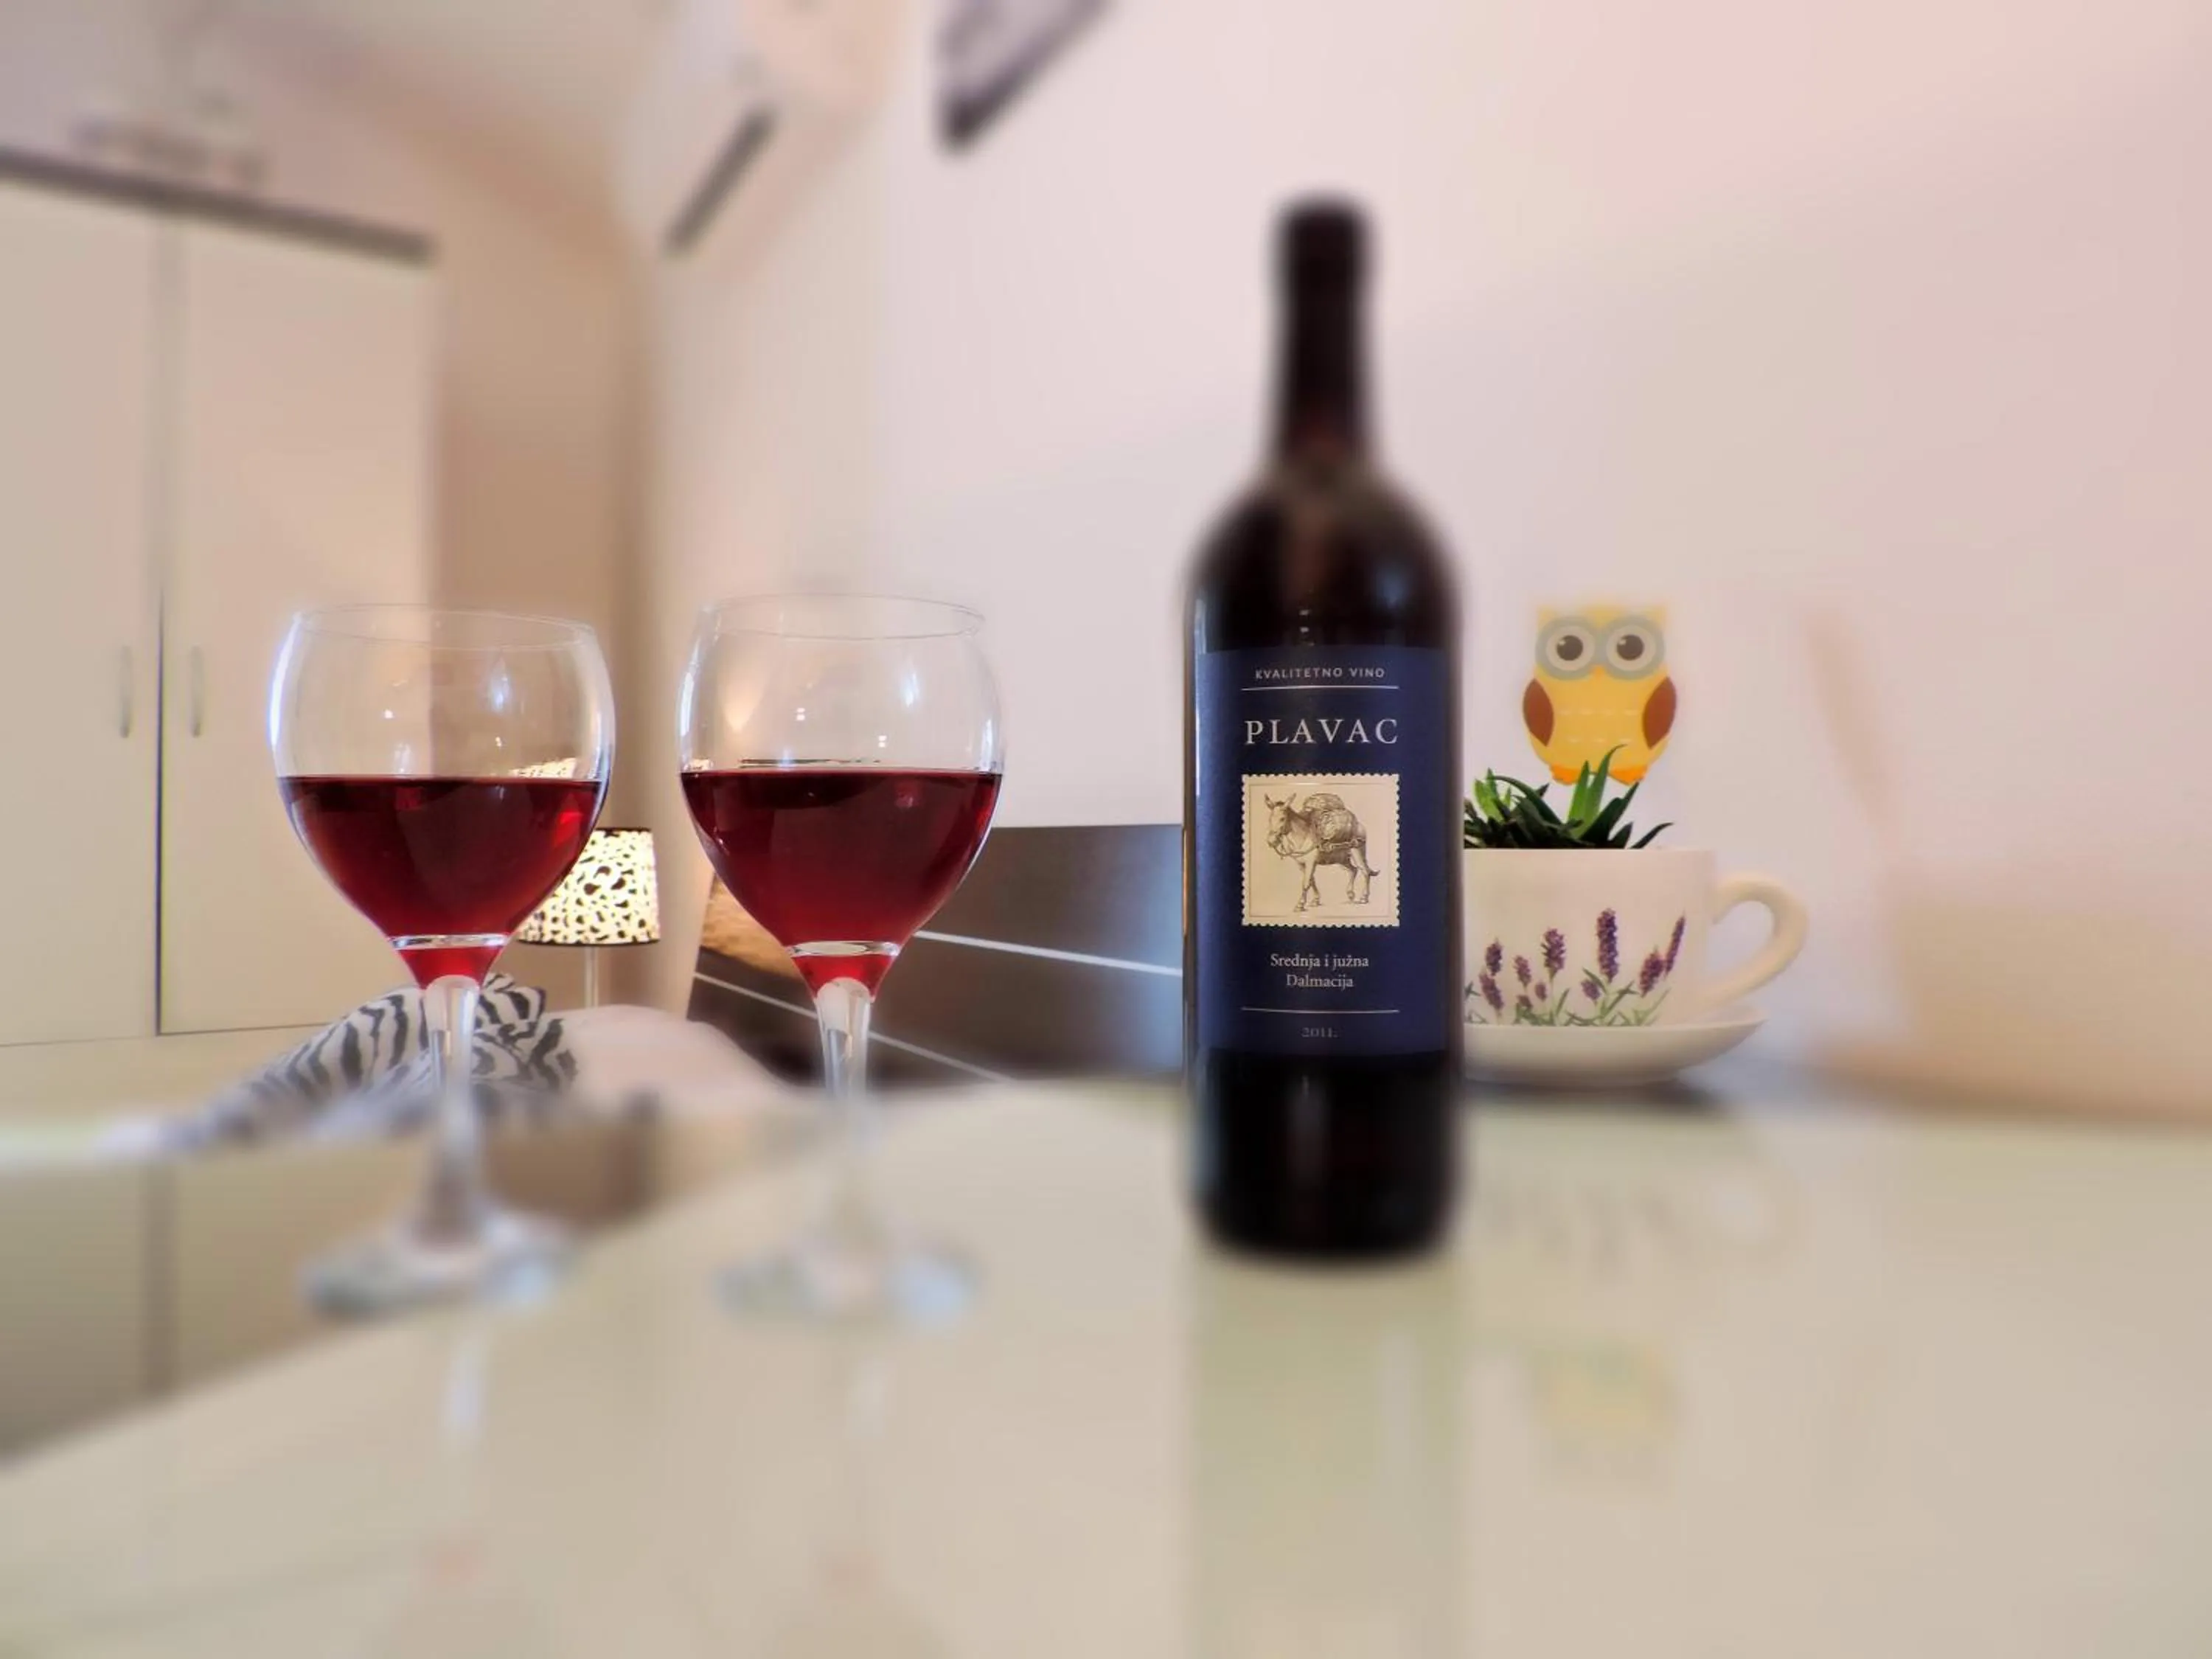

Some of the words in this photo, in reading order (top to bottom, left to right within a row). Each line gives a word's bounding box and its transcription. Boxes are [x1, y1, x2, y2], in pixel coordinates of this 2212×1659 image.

[1256, 667, 1343, 680] KVALITETNO
[1349, 667, 1385, 678] VINO
[1245, 718, 1398, 745] PLAVAC
[1270, 953, 1321, 970] Srednja
[1324, 954, 1329, 967] i
[1332, 954, 1369, 970] južna
[1286, 973, 1354, 990] Dalmacija
